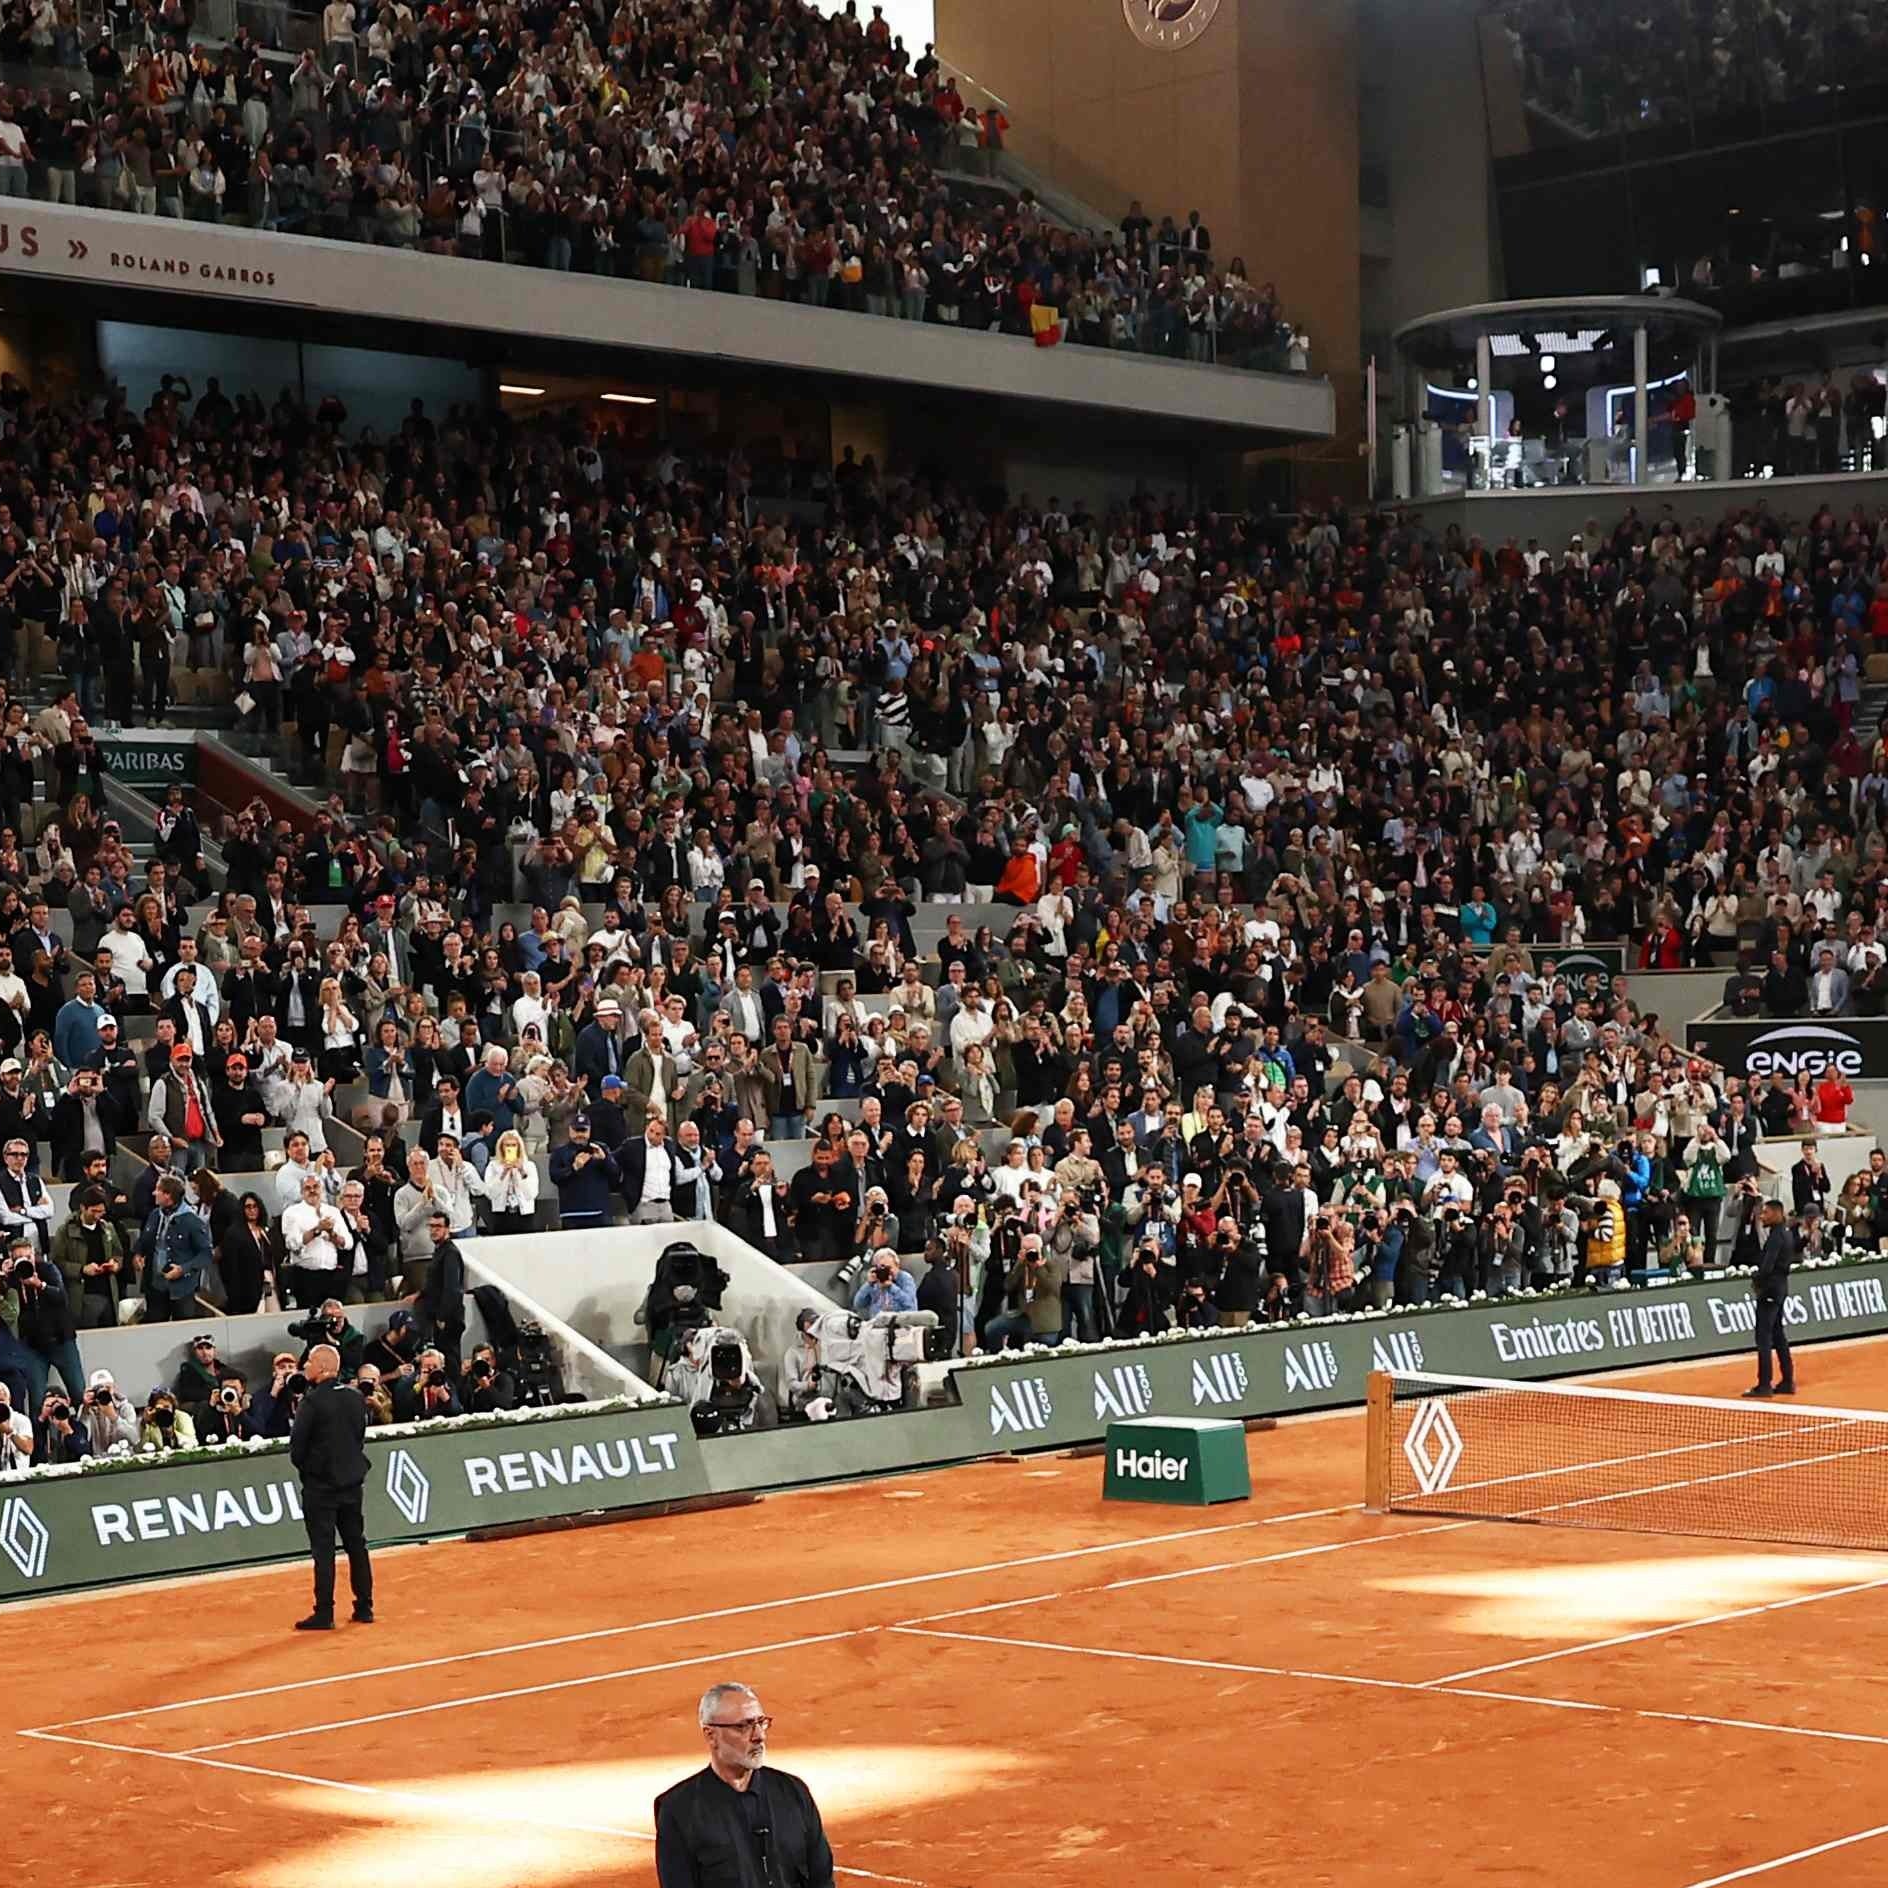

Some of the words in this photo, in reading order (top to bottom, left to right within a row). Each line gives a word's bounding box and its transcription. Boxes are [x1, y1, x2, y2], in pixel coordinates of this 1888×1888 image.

[110, 252, 191, 278] ROLAND
[199, 263, 276, 286] GARROS
[1810, 1285, 1835, 1320] FLY
[1836, 1278, 1886, 1317] BETTER
[1490, 1316, 1604, 1362] Emirates
[1609, 1307, 1637, 1348] FLY
[1637, 1302, 1695, 1344] BETTER
[464, 1433, 679, 1497] RENAULT
[1116, 1448, 1189, 1481] Haier
[91, 1480, 306, 1545] RENAUL
